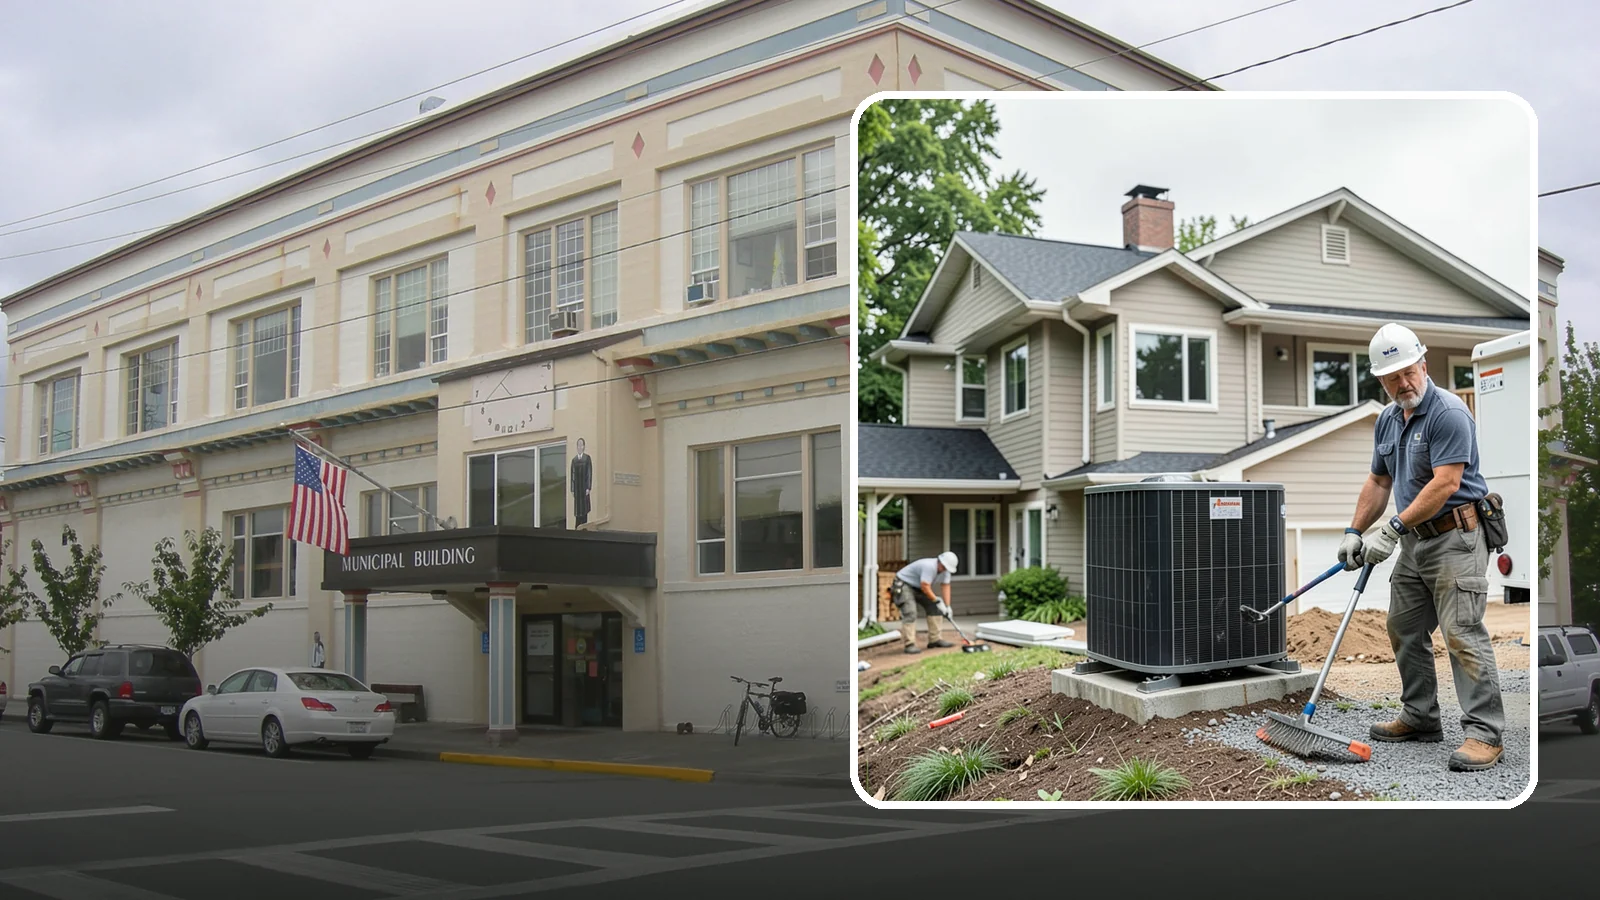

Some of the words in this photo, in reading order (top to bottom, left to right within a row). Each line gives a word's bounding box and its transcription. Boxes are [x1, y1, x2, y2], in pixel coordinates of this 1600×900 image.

[487, 417, 492, 426] 9
[494, 423, 500, 432] 10
[507, 425, 513, 433] 12
[521, 420, 525, 428] 2
[536, 402, 540, 410] 4
[342, 552, 406, 572] MUNICIPAL
[414, 546, 475, 567] BUILDING
